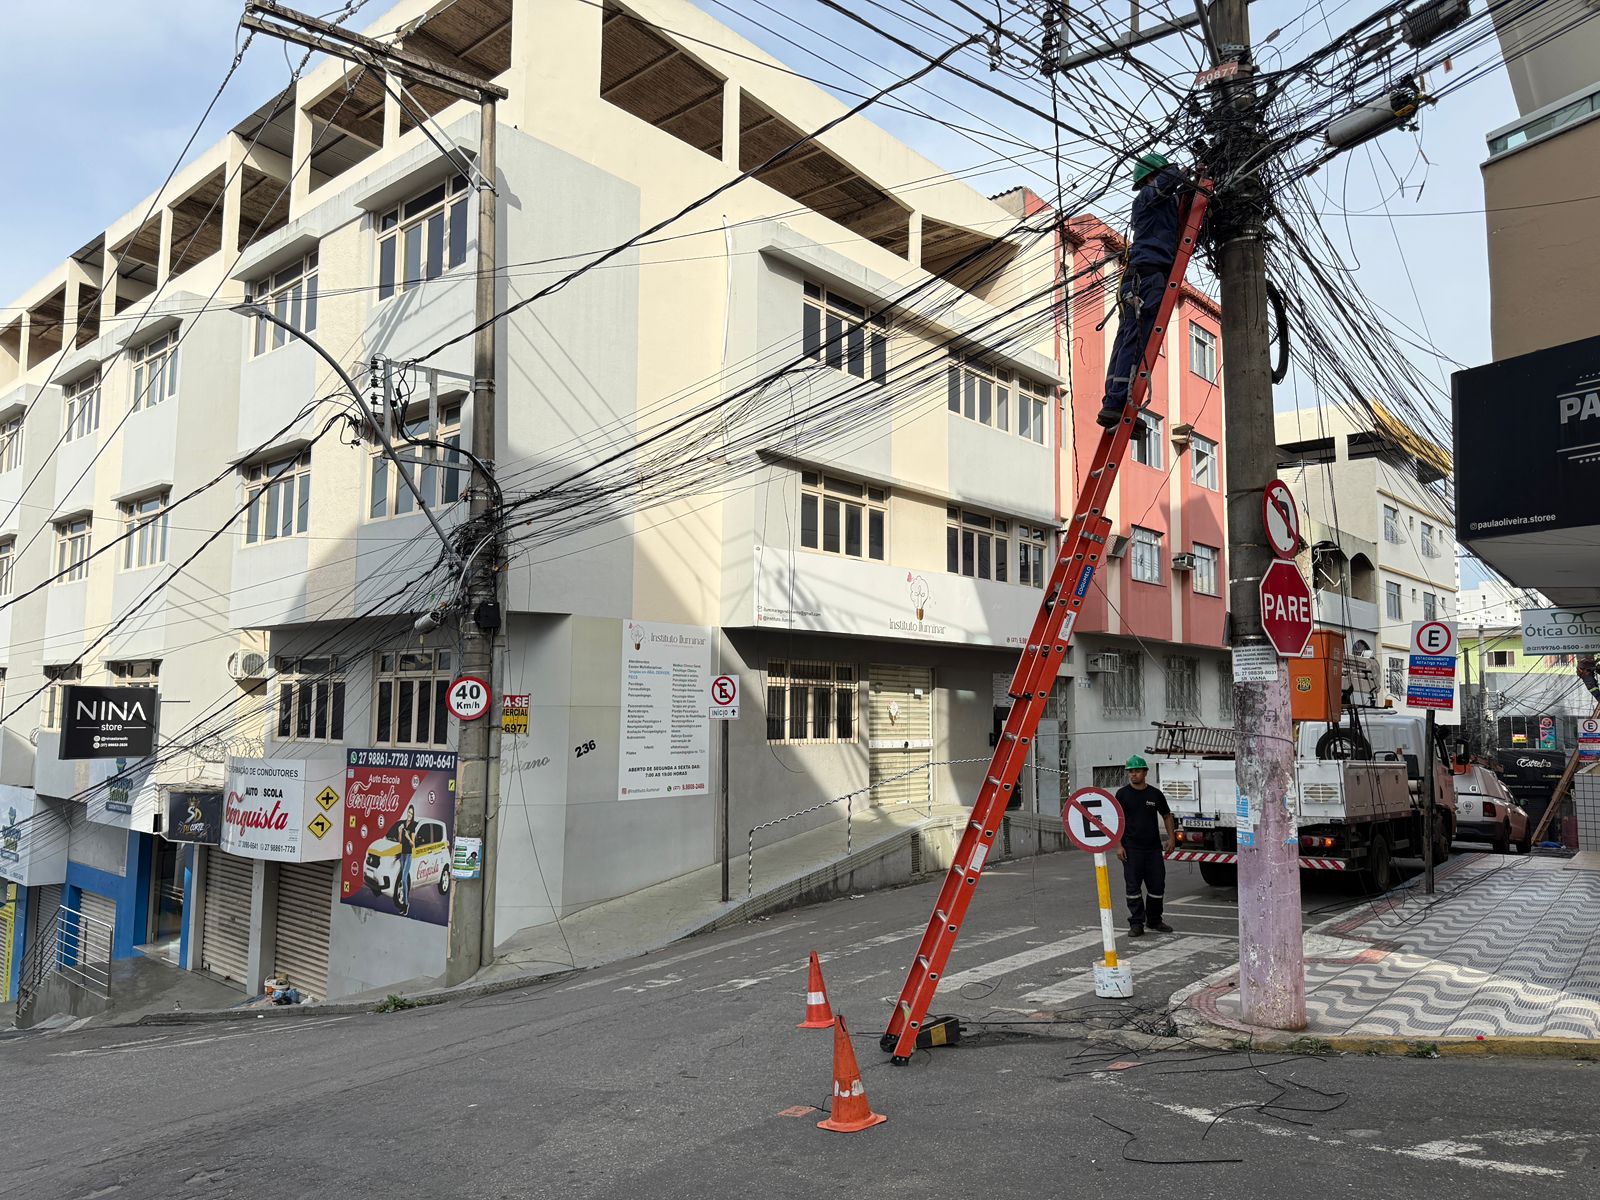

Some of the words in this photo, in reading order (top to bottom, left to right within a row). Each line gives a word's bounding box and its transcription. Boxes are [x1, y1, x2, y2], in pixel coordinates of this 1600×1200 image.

[1077, 566, 1092, 595] COGUMELO
[1263, 593, 1310, 623] PARE
[889, 618, 917, 632] Instituto
[1524, 623, 1563, 637] Ótica
[1427, 629, 1440, 647] E
[455, 684, 481, 700] 40
[719, 682, 728, 698] E
[77, 700, 147, 721] NINA
[456, 701, 480, 710] Km/h
[101, 723, 123, 731] store
[1587, 722, 1594, 730] E
[574, 739, 597, 758] 236
[358, 751, 368, 765] 27
[368, 752, 409, 766] 98861-7728
[415, 754, 455, 769] 3090-6641
[249, 768, 256, 776] DE
[256, 768, 299, 778] CONDUTORES
[368, 774, 382, 784] Auto
[382, 775, 401, 785] Escola
[245, 787, 258, 797] AUTO
[346, 781, 400, 818] Conquista
[225, 791, 289, 837] Conquista
[1080, 799, 1107, 838] E
[270, 845, 296, 854] 98861-7728
